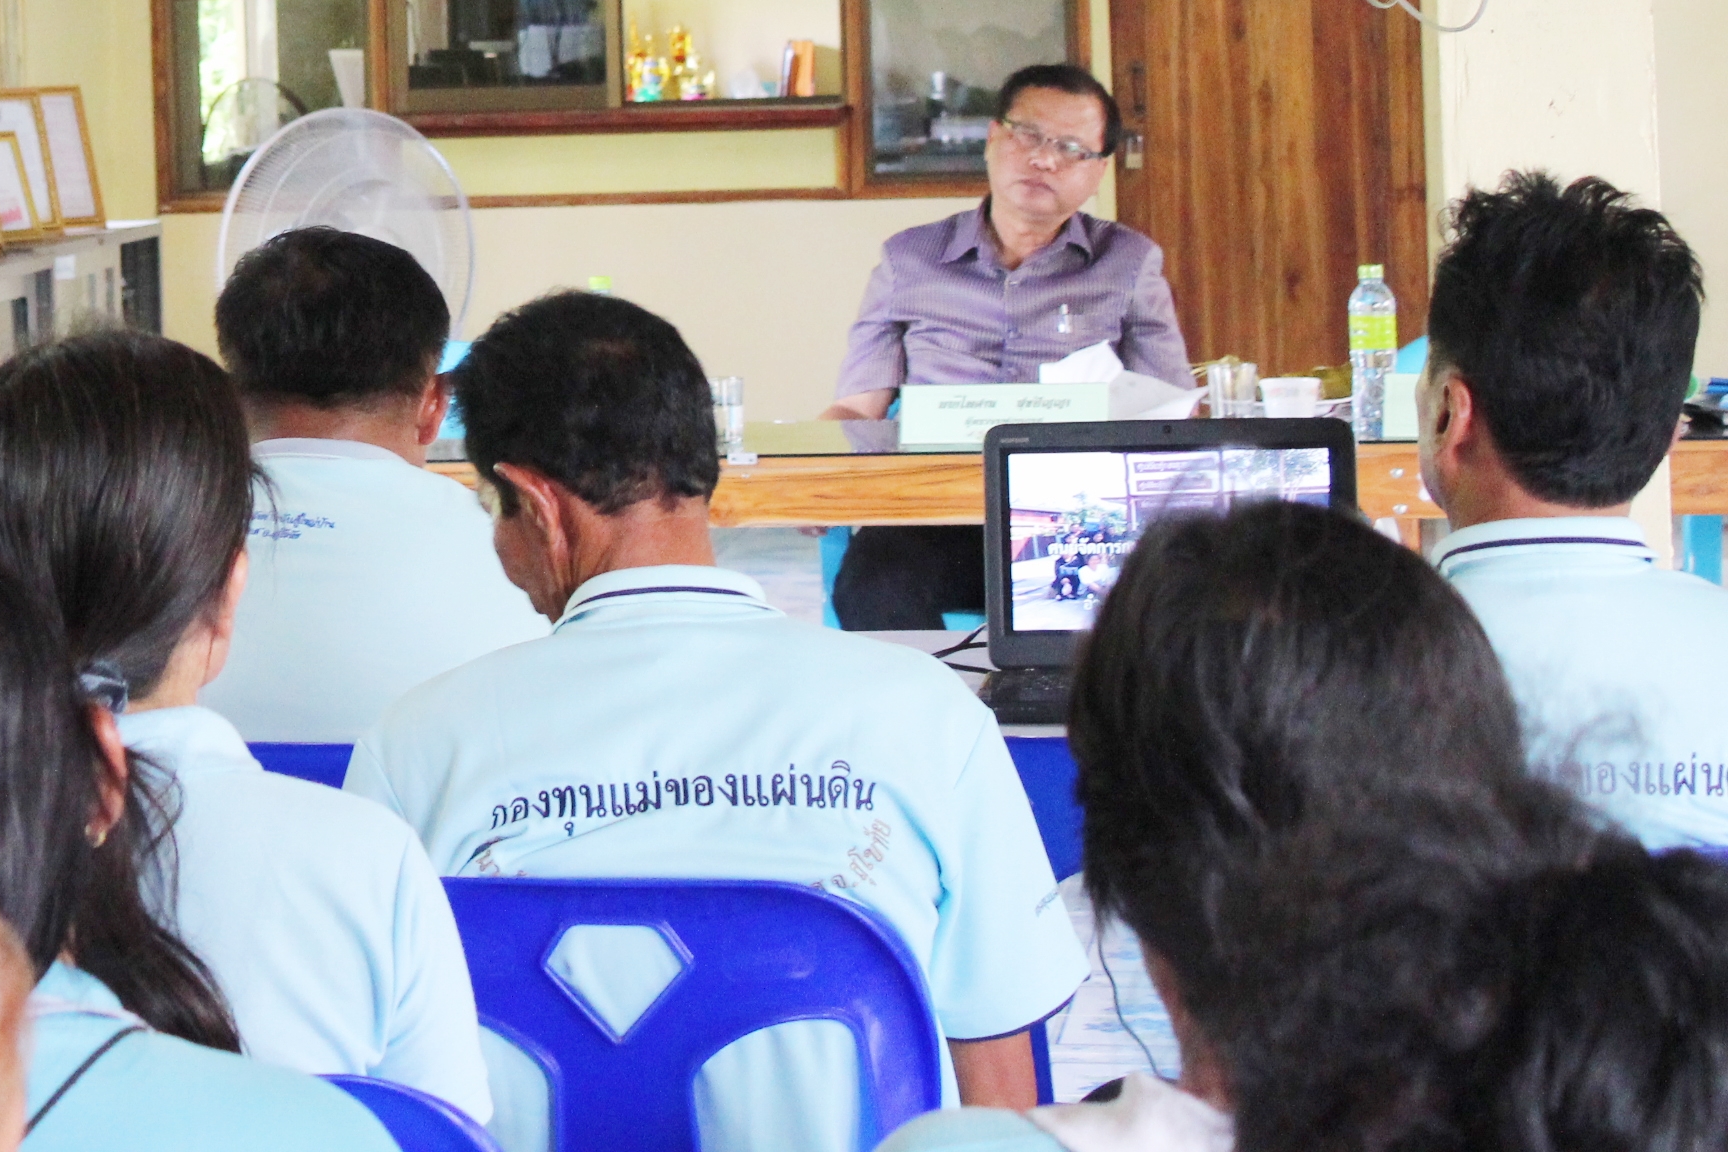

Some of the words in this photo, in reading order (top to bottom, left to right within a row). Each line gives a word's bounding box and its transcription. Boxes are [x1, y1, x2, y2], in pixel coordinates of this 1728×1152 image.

[490, 760, 878, 836] กองทุนแม่ของแผ่นดิน
